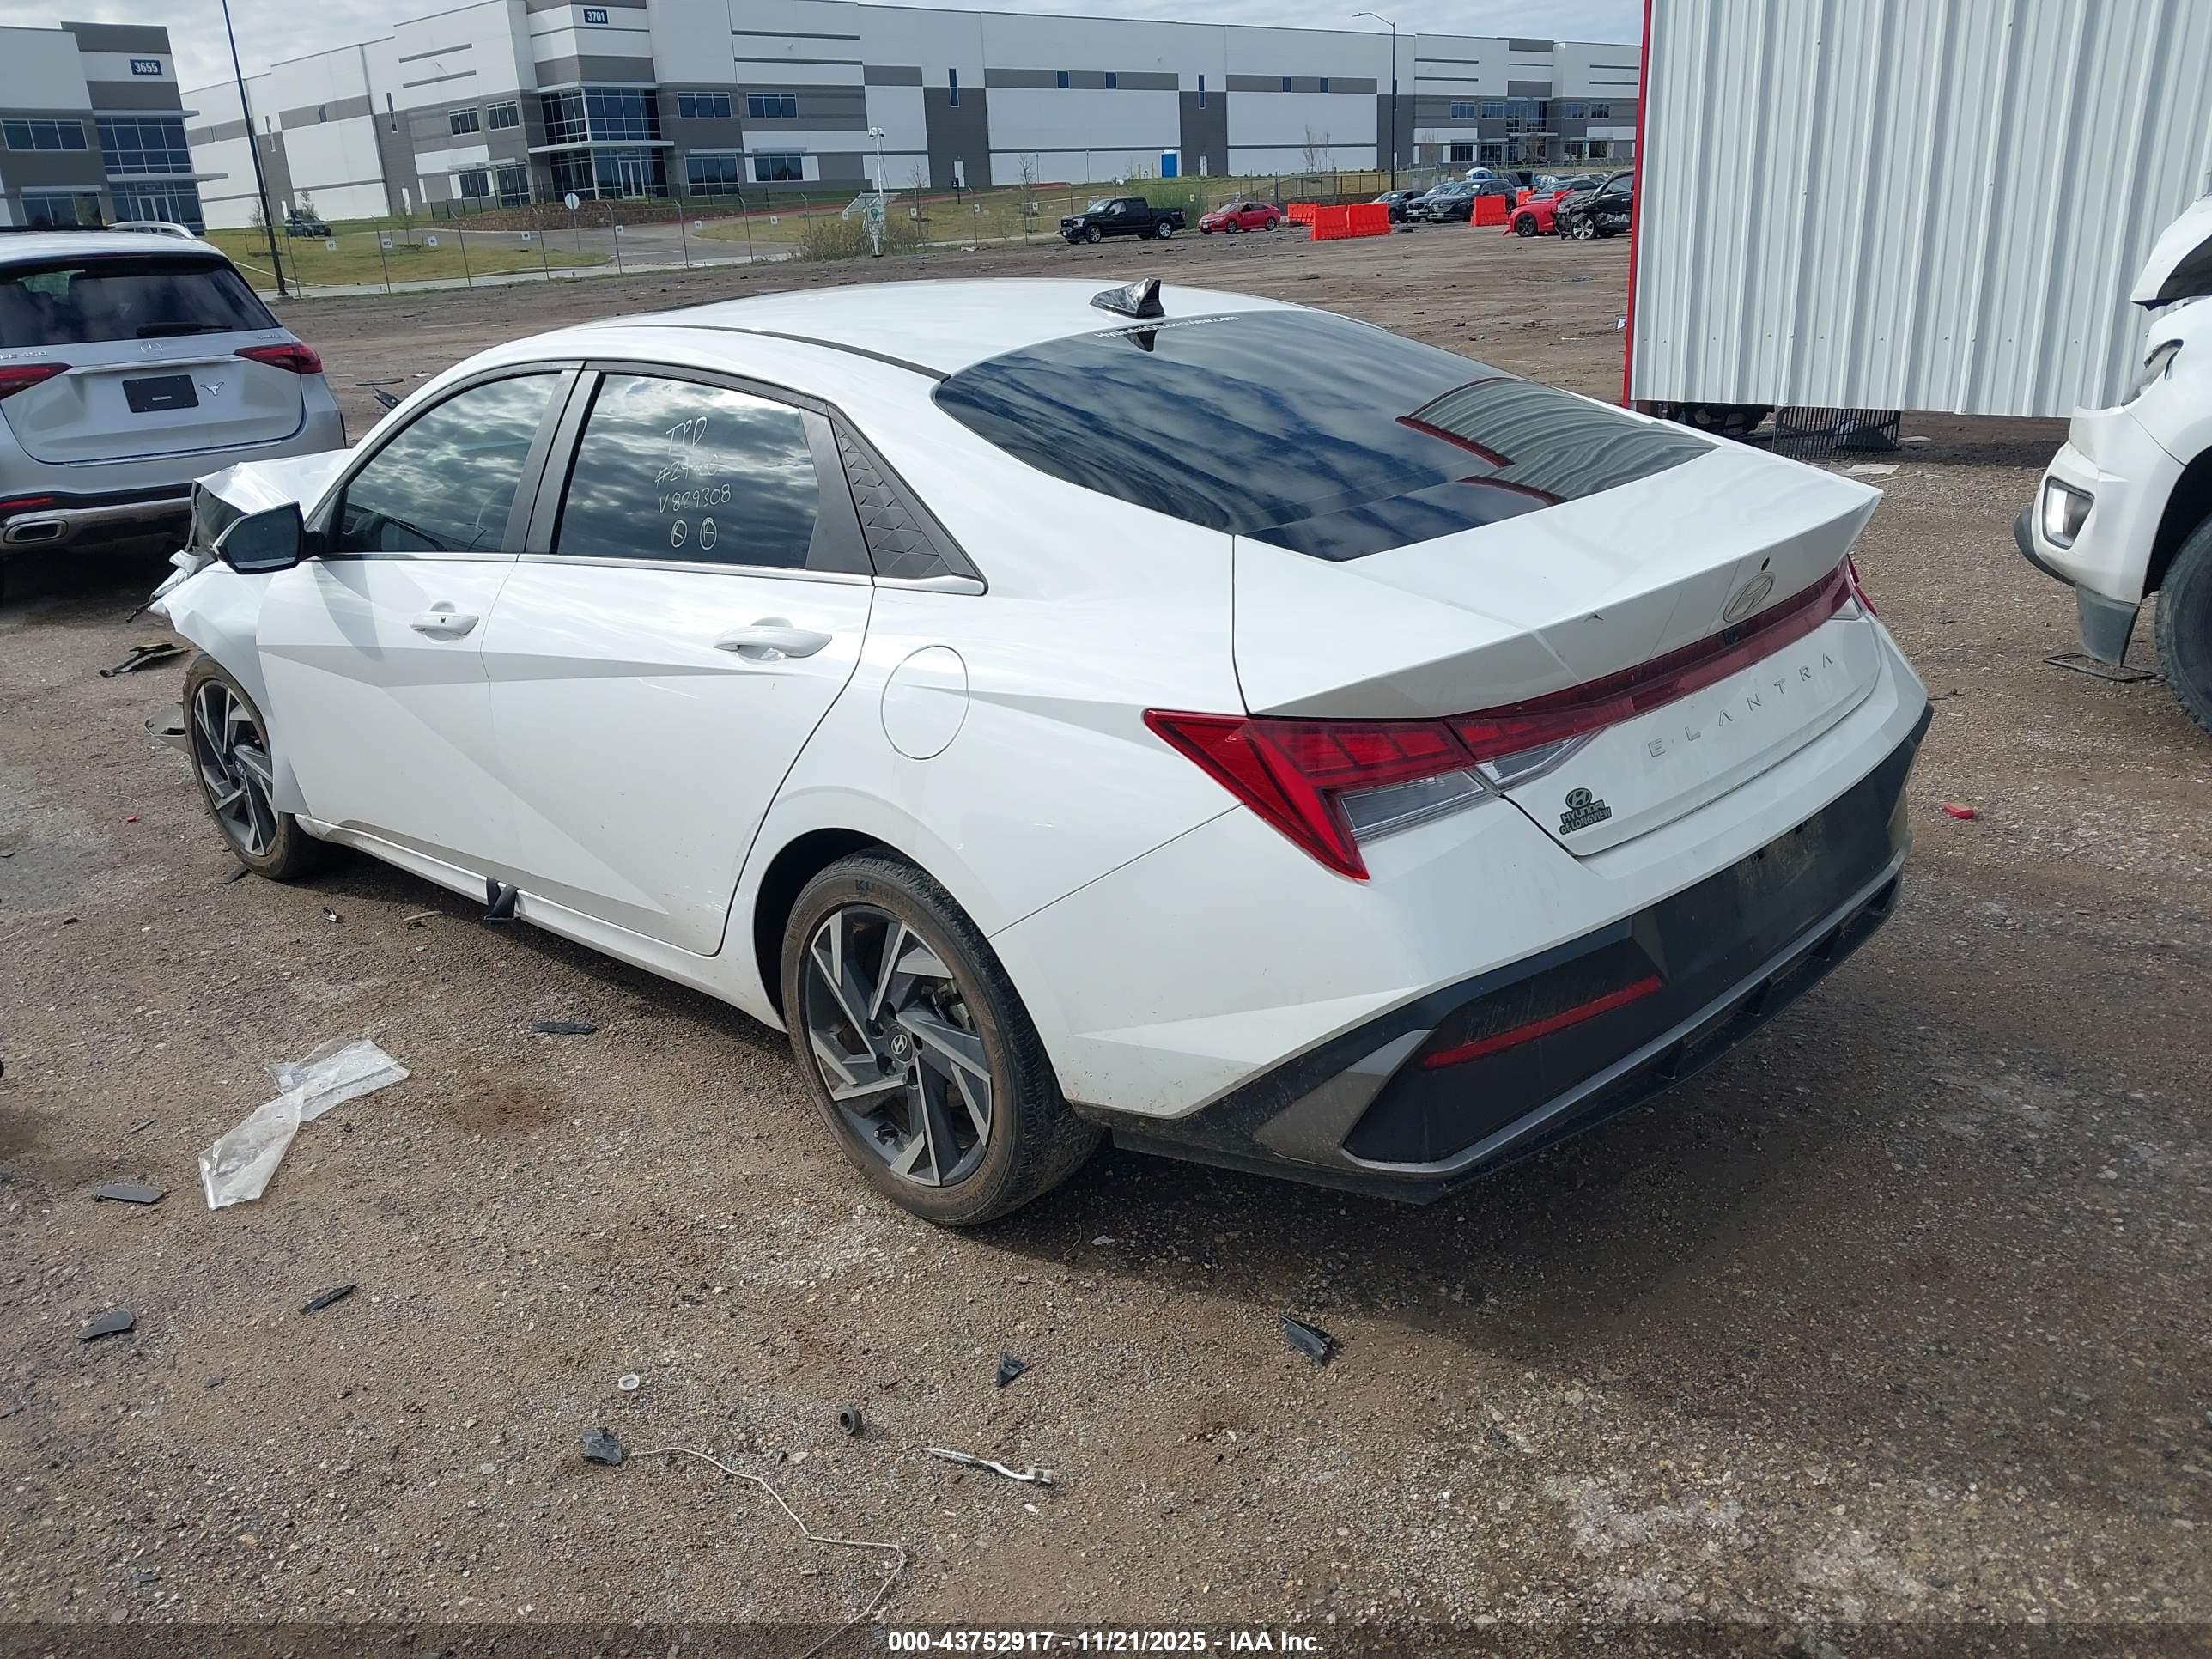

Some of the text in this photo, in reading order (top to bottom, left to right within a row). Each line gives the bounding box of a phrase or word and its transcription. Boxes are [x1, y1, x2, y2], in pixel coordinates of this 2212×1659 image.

[586, 11, 605, 22] 3701
[134, 62, 158, 73] 3655
[1647, 652, 1833, 757] ELANTRA
[1561, 799, 1605, 823] HYUNDAI
[1571, 807, 1611, 830] LONGVIEW
